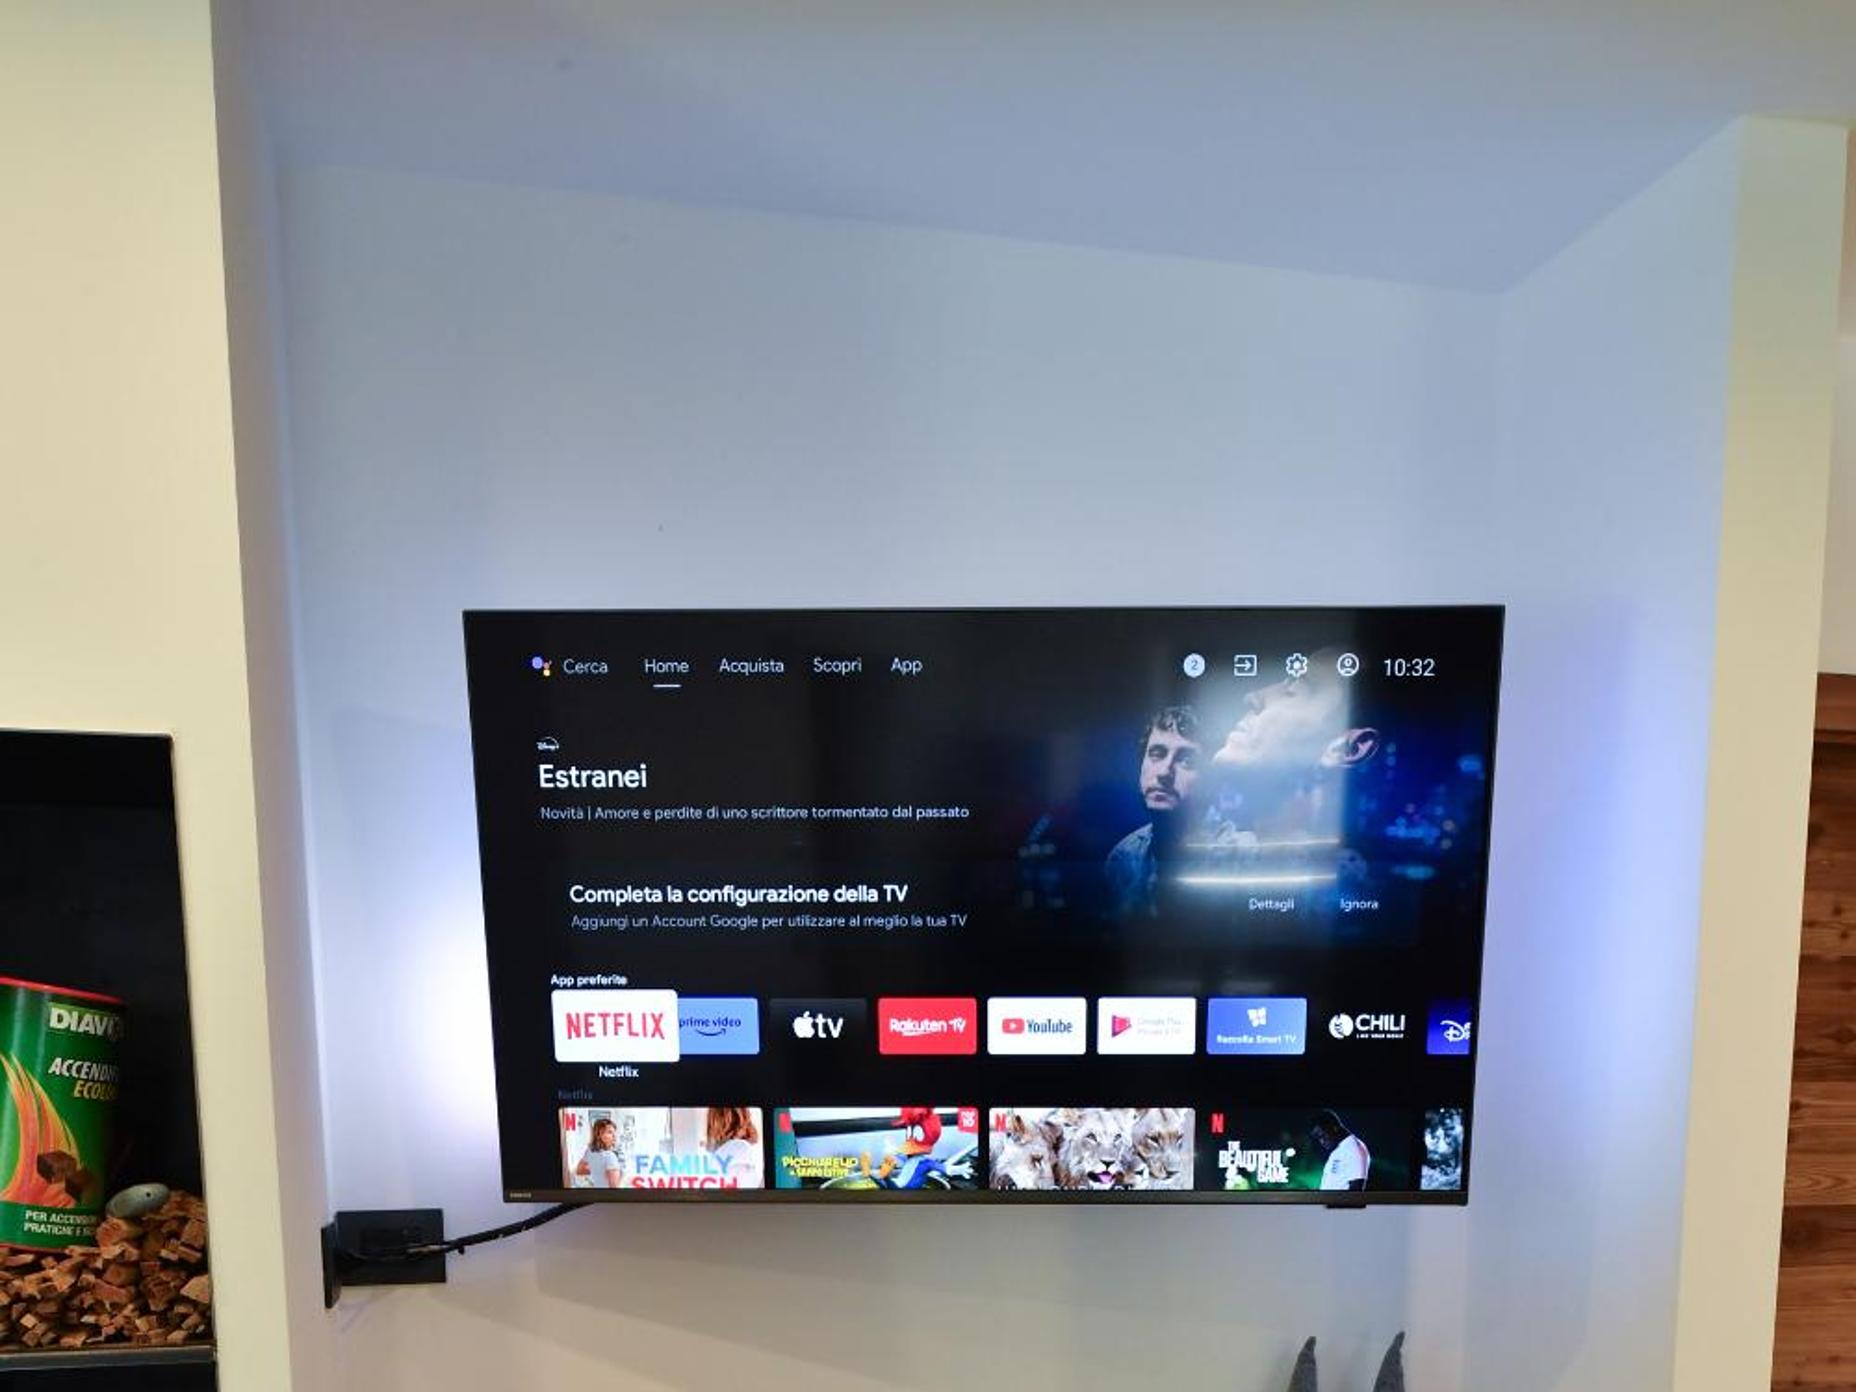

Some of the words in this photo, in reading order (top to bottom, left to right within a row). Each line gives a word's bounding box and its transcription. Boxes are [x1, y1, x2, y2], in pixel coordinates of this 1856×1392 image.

[563, 659, 608, 674] Cerca
[645, 659, 689, 672] Home
[720, 658, 784, 675] Acquista
[814, 657, 861, 675] Scopri
[891, 658, 923, 675] App
[1384, 658, 1435, 677] 10:32
[539, 763, 646, 788] Estranei
[541, 807, 583, 819] Novità
[595, 807, 639, 819] Amore
[642, 809, 652, 819] e
[655, 807, 702, 821] perdite
[706, 806, 719, 819] di
[722, 809, 749, 819] uno
[751, 806, 808, 819] scrittore
[812, 807, 889, 818] tormentato
[892, 806, 912, 817] dal
[916, 807, 969, 821] passato
[570, 885, 663, 906] Completa
[667, 885, 683, 902] la
[687, 885, 830, 907] configurazione
[833, 885, 878, 902] della
[883, 884, 908, 902] TV
[1249, 898, 1295, 911] Dettagli
[1340, 898, 1379, 912] Ignora
[572, 915, 629, 930] Aggiungi
[632, 918, 648, 927] un
[651, 915, 706, 927] Account
[710, 914, 758, 930] Google
[762, 917, 783, 929] per
[788, 915, 845, 927] utilizzare
[848, 915, 860, 926] al
[863, 914, 908, 930] meglio
[911, 915, 923, 927] la
[926, 916, 947, 927] tua
[950, 914, 967, 926] TV
[551, 974, 574, 986] App
[577, 974, 628, 986] preferite
[565, 1012, 665, 1040] NETFLIX
[679, 1017, 710, 1029] prime
[713, 1016, 742, 1028] video
[816, 1014, 844, 1038] tv
[889, 1018, 947, 1036] Rakuten
[949, 1017, 966, 1033] TV
[1027, 1018, 1073, 1033] YouTube
[1355, 1014, 1405, 1031] CHILI
[599, 1066, 639, 1078] Netflix
[635, 1155, 734, 1175] FAMILY
[632, 1177, 738, 1188] SWITCH
[25, 1210, 47, 1222] PER
